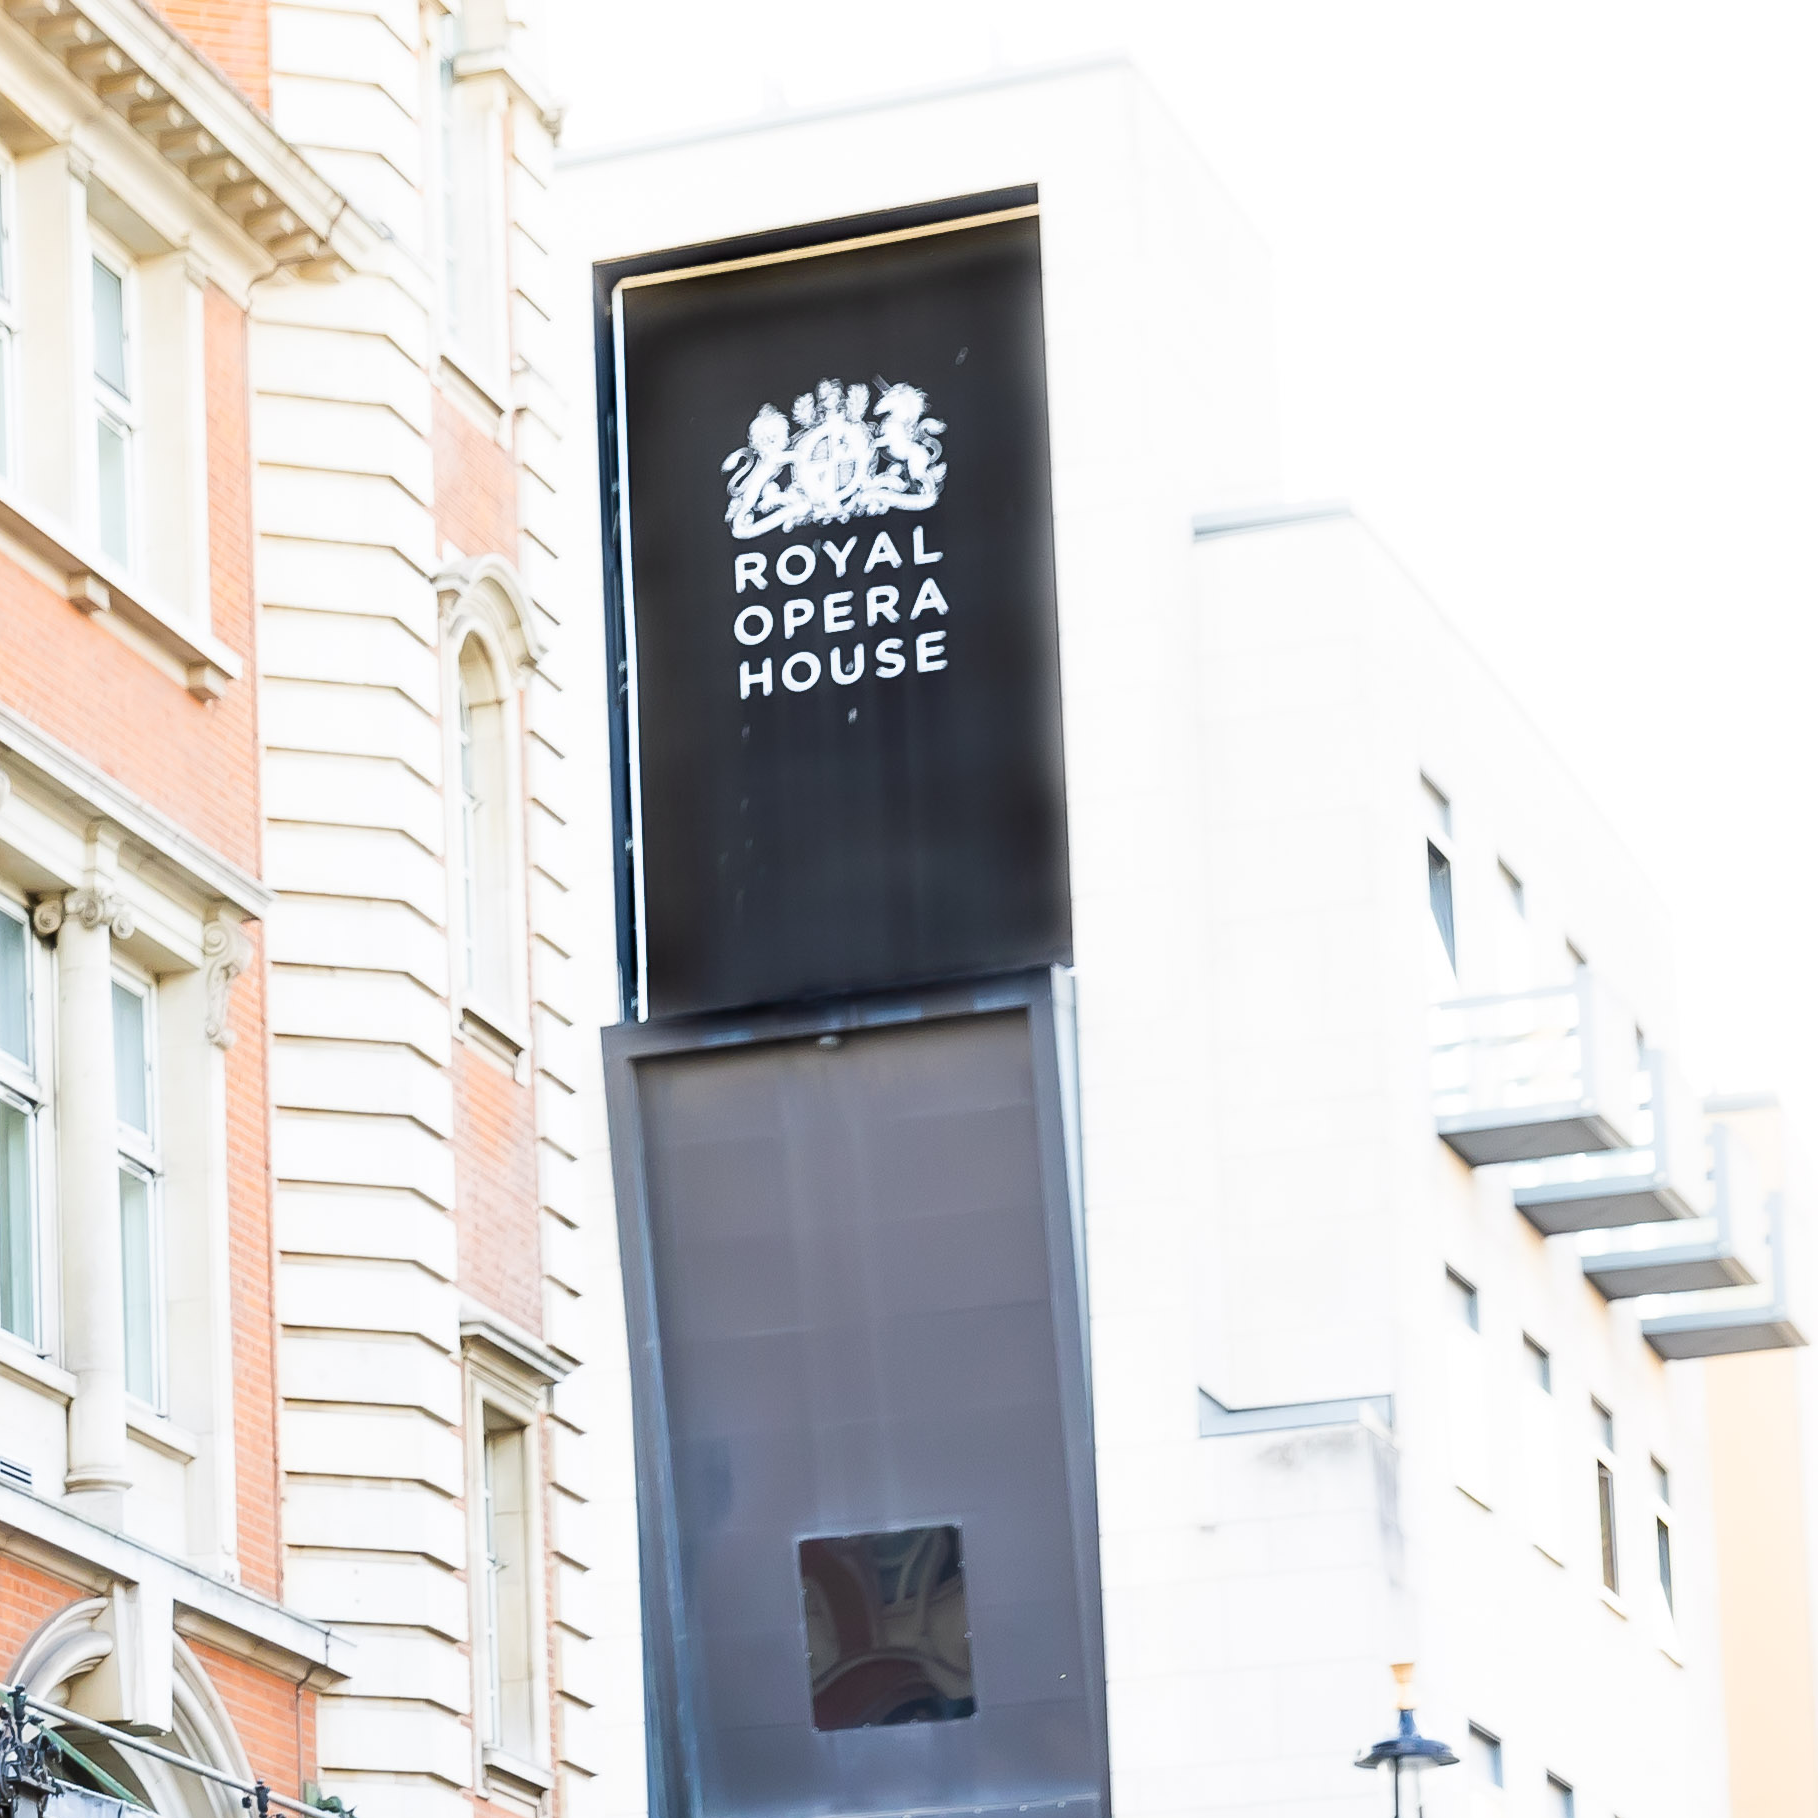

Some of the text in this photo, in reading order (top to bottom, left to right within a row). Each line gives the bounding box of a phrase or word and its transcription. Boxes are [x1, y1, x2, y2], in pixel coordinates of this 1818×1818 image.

[735, 526, 943, 593] ROYAL
[734, 578, 949, 645] OPERA
[739, 630, 947, 700] HOUSE
